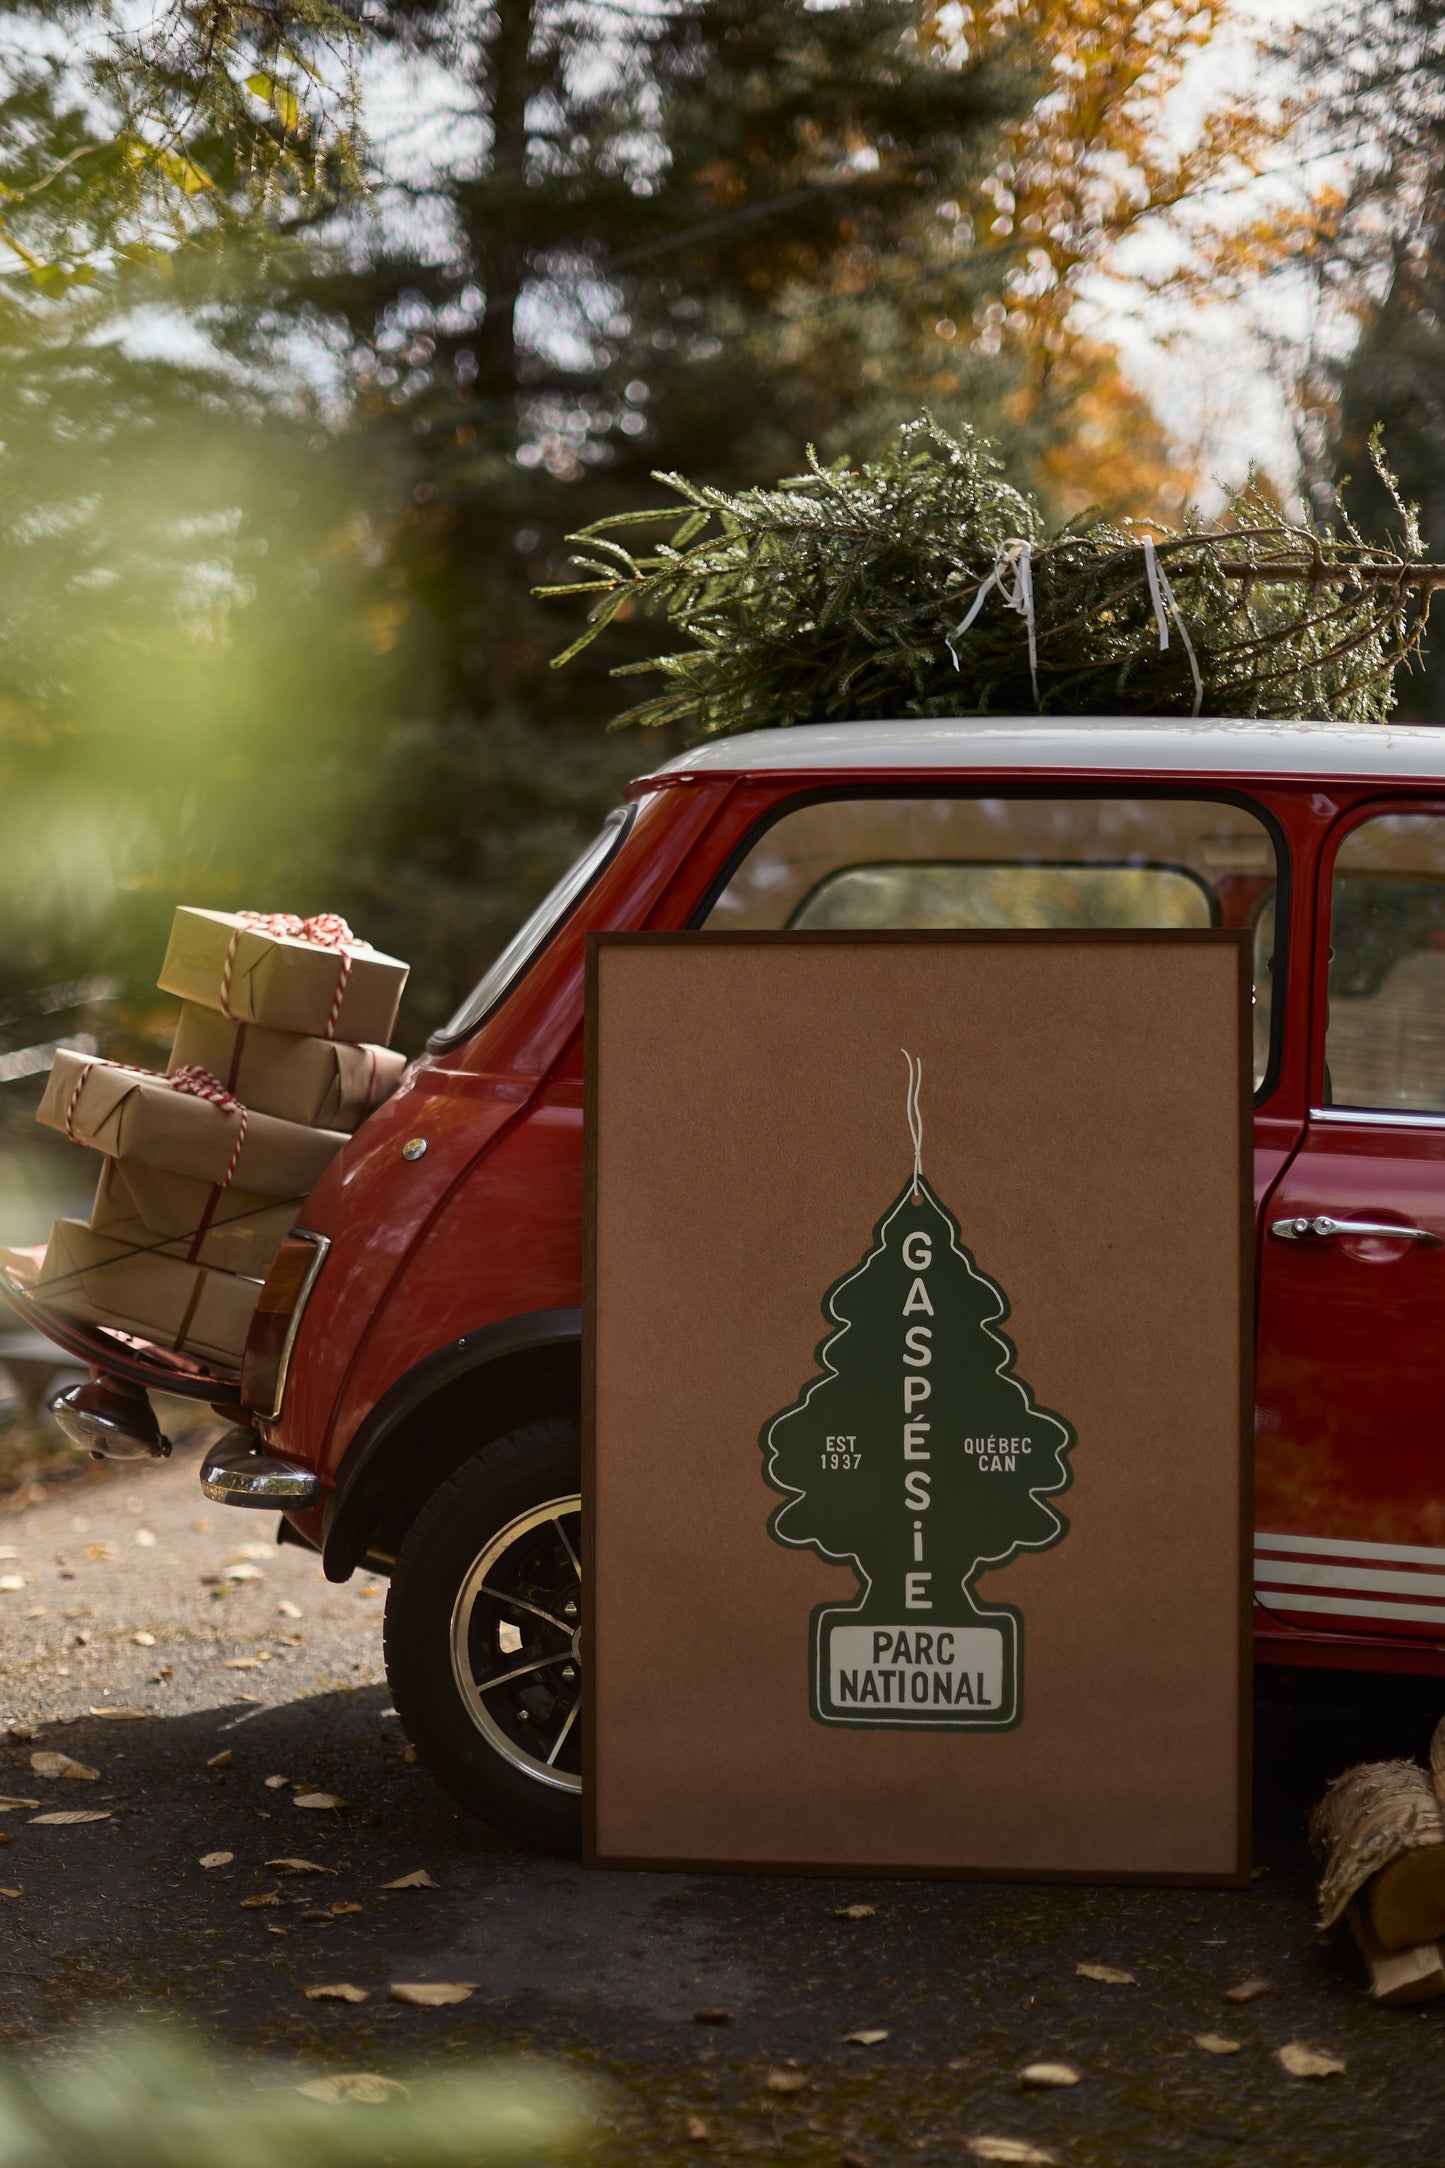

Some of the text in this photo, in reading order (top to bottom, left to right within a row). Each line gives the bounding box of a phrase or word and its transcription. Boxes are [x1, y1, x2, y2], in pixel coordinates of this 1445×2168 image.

[825, 1435, 857, 1453] EST
[963, 1434, 1032, 1455] QUÉBEC
[820, 1453, 862, 1470] 1937
[978, 1455, 1016, 1472] CAN
[871, 1630, 956, 1667] PARC
[838, 1668, 993, 1706] NATIONAL
